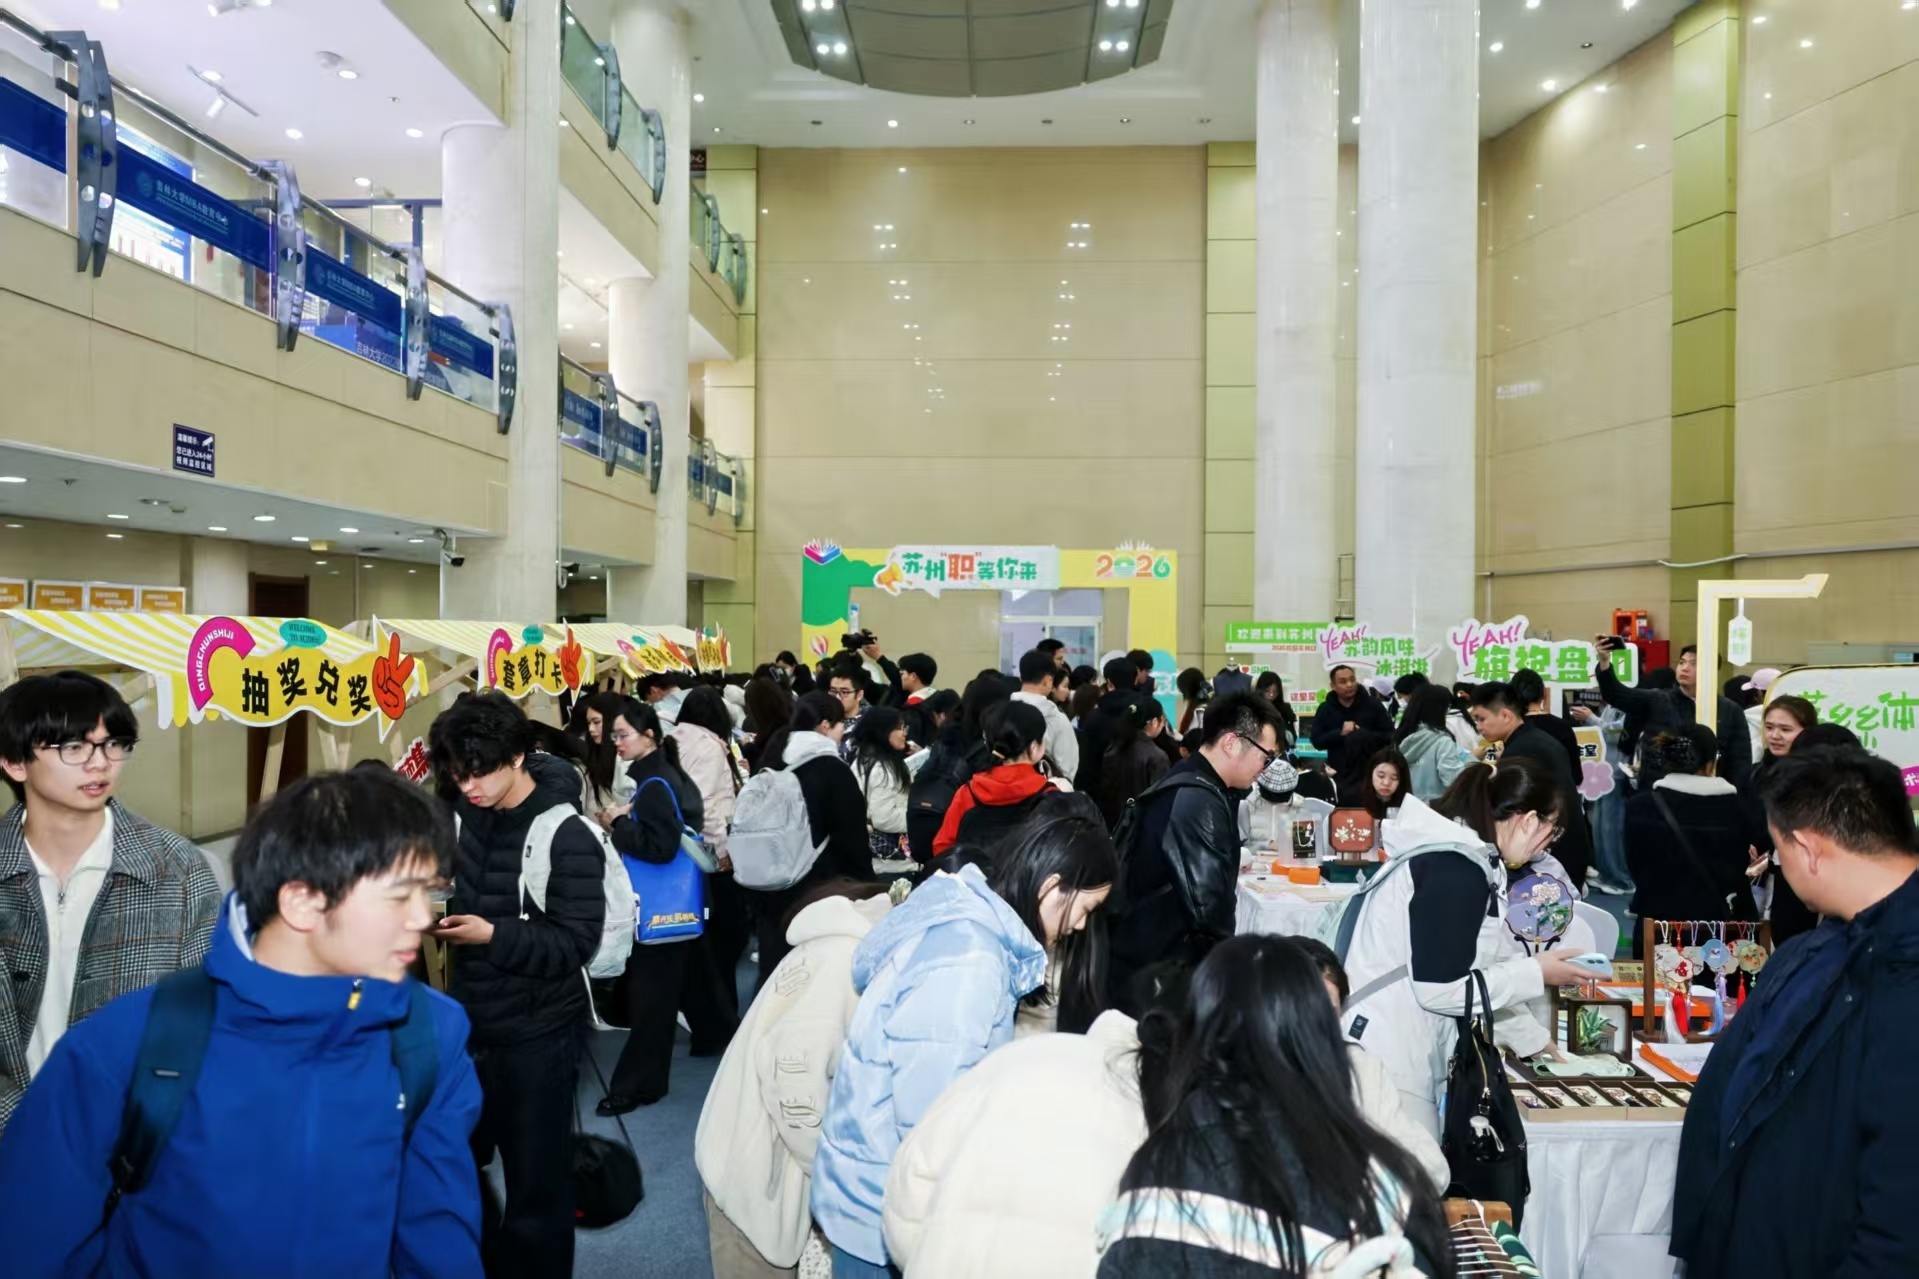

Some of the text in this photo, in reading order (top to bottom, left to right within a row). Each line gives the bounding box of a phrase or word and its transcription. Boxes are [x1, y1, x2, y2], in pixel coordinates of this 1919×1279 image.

[176, 456, 212, 470] 视频监控区域
[1096, 554, 1171, 579] 2026
[1344, 636, 1415, 657] 苏韵风味
[242, 657, 372, 717] 抽奖兑奖
